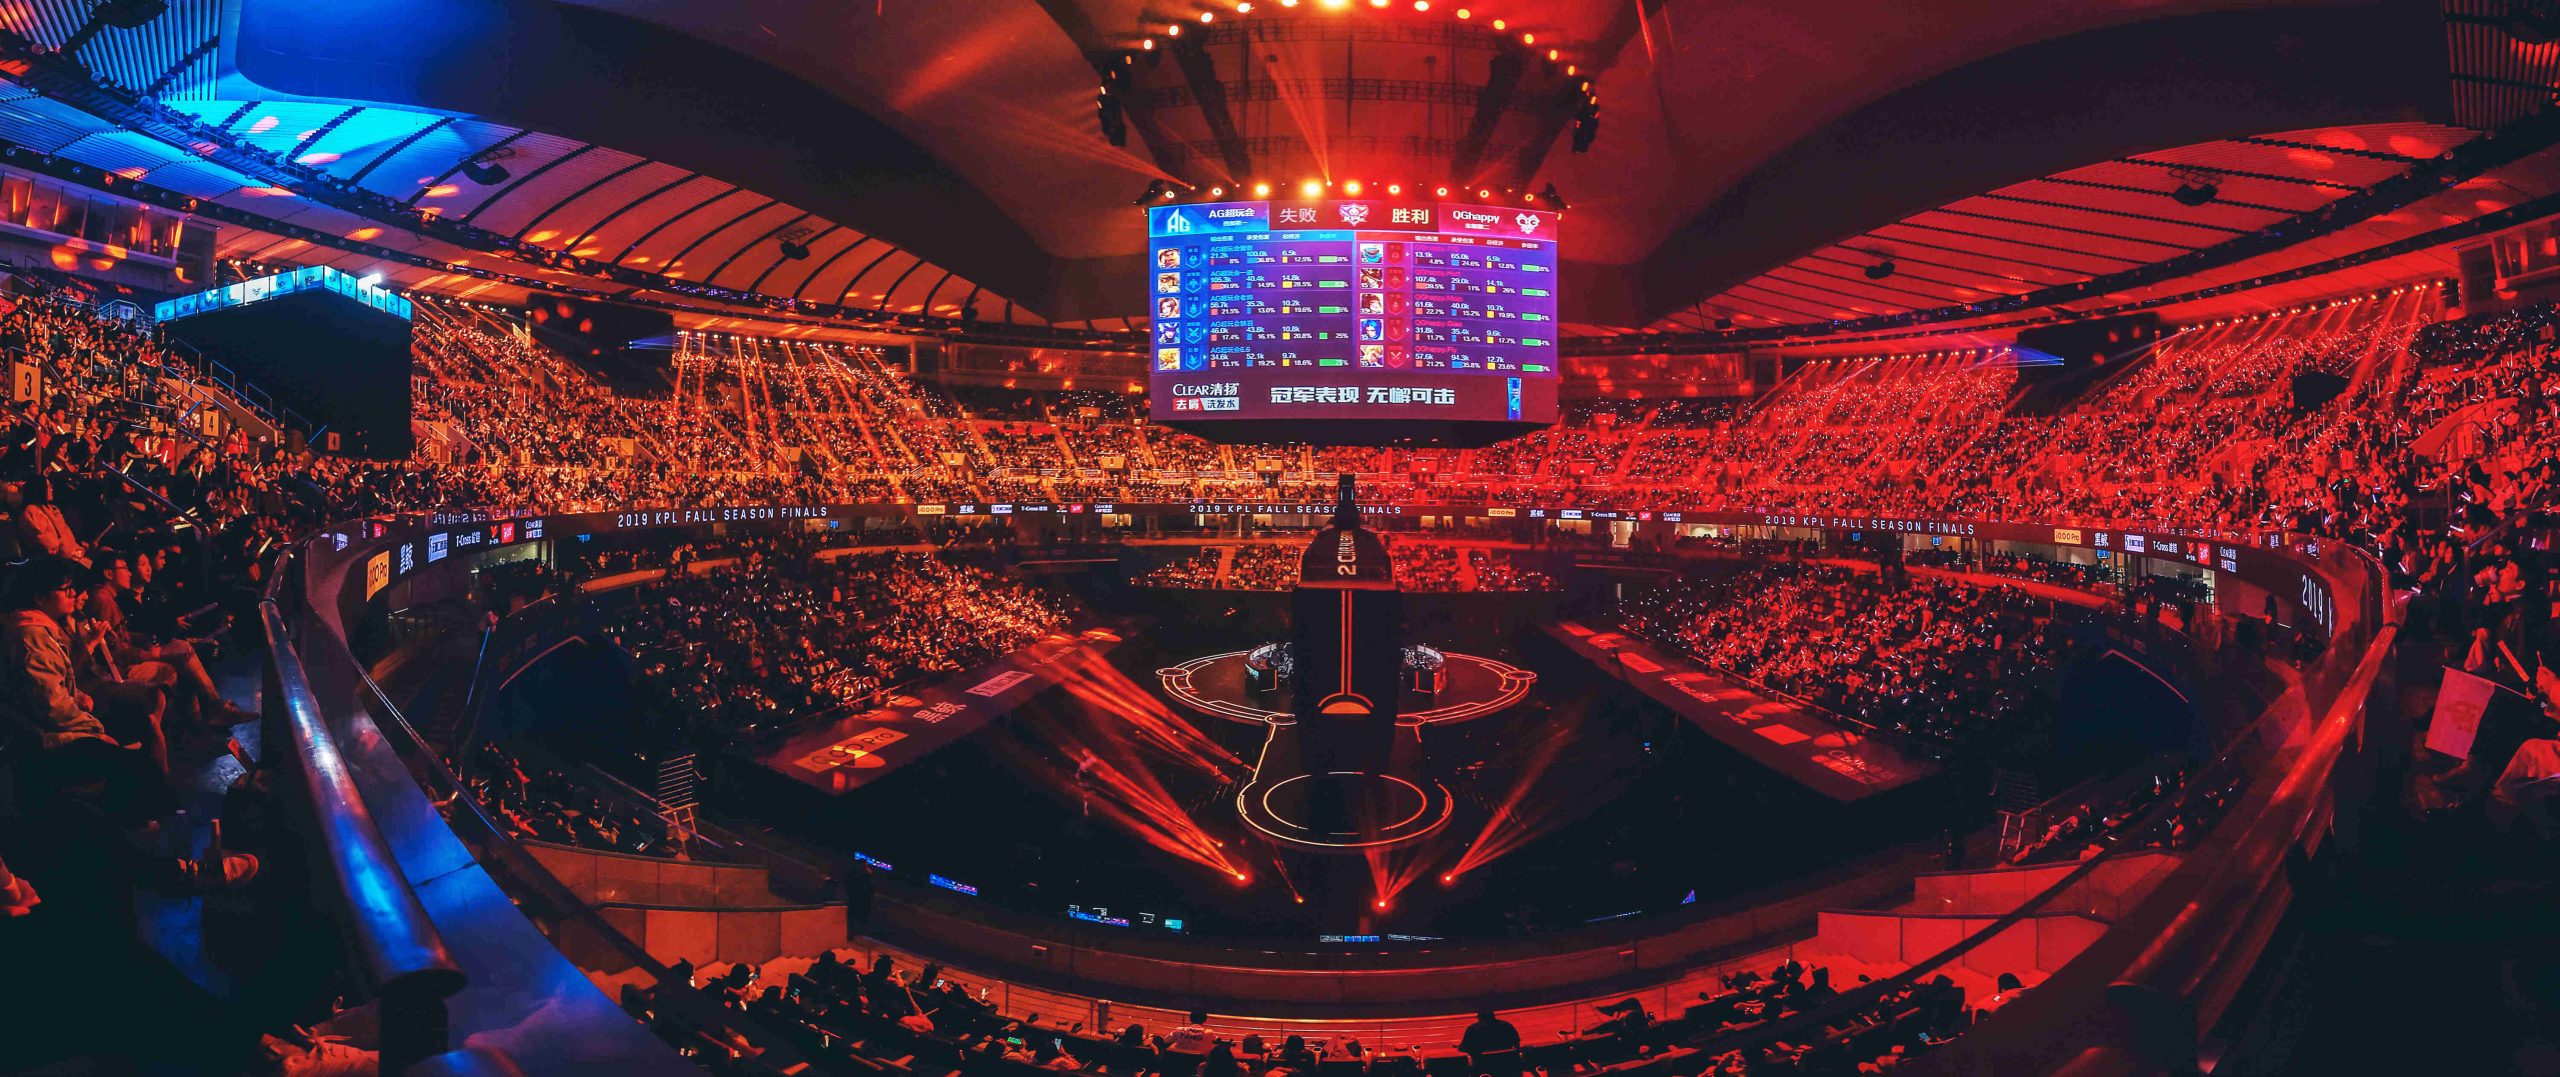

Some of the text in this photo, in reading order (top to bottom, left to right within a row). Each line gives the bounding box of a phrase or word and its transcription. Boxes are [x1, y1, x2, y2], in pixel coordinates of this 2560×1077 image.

[1279, 208, 1317, 223] 失败
[1391, 208, 1429, 224] 胜利
[1452, 210, 1500, 225] QGhappy
[1451, 277, 1469, 285] 29.0k
[25, 372, 32, 397] 3
[1270, 387, 1456, 405] 冠军表现 无懈可击
[1175, 399, 1236, 411] 去屑 洗发水
[1190, 504, 1221, 514] 2019
[1228, 504, 1251, 513] KPL
[1258, 505, 1290, 514] FALL
[618, 506, 828, 528] 2019 KPL FALL SEASON FINALS
[1765, 515, 1975, 535] 2019 KPL FALL SEASON FINALS
[456, 535, 472, 547] T-Cross
[2071, 534, 2080, 542] Pro
[2152, 540, 2169, 552] T-Cross
[2302, 574, 2323, 626] 2019
